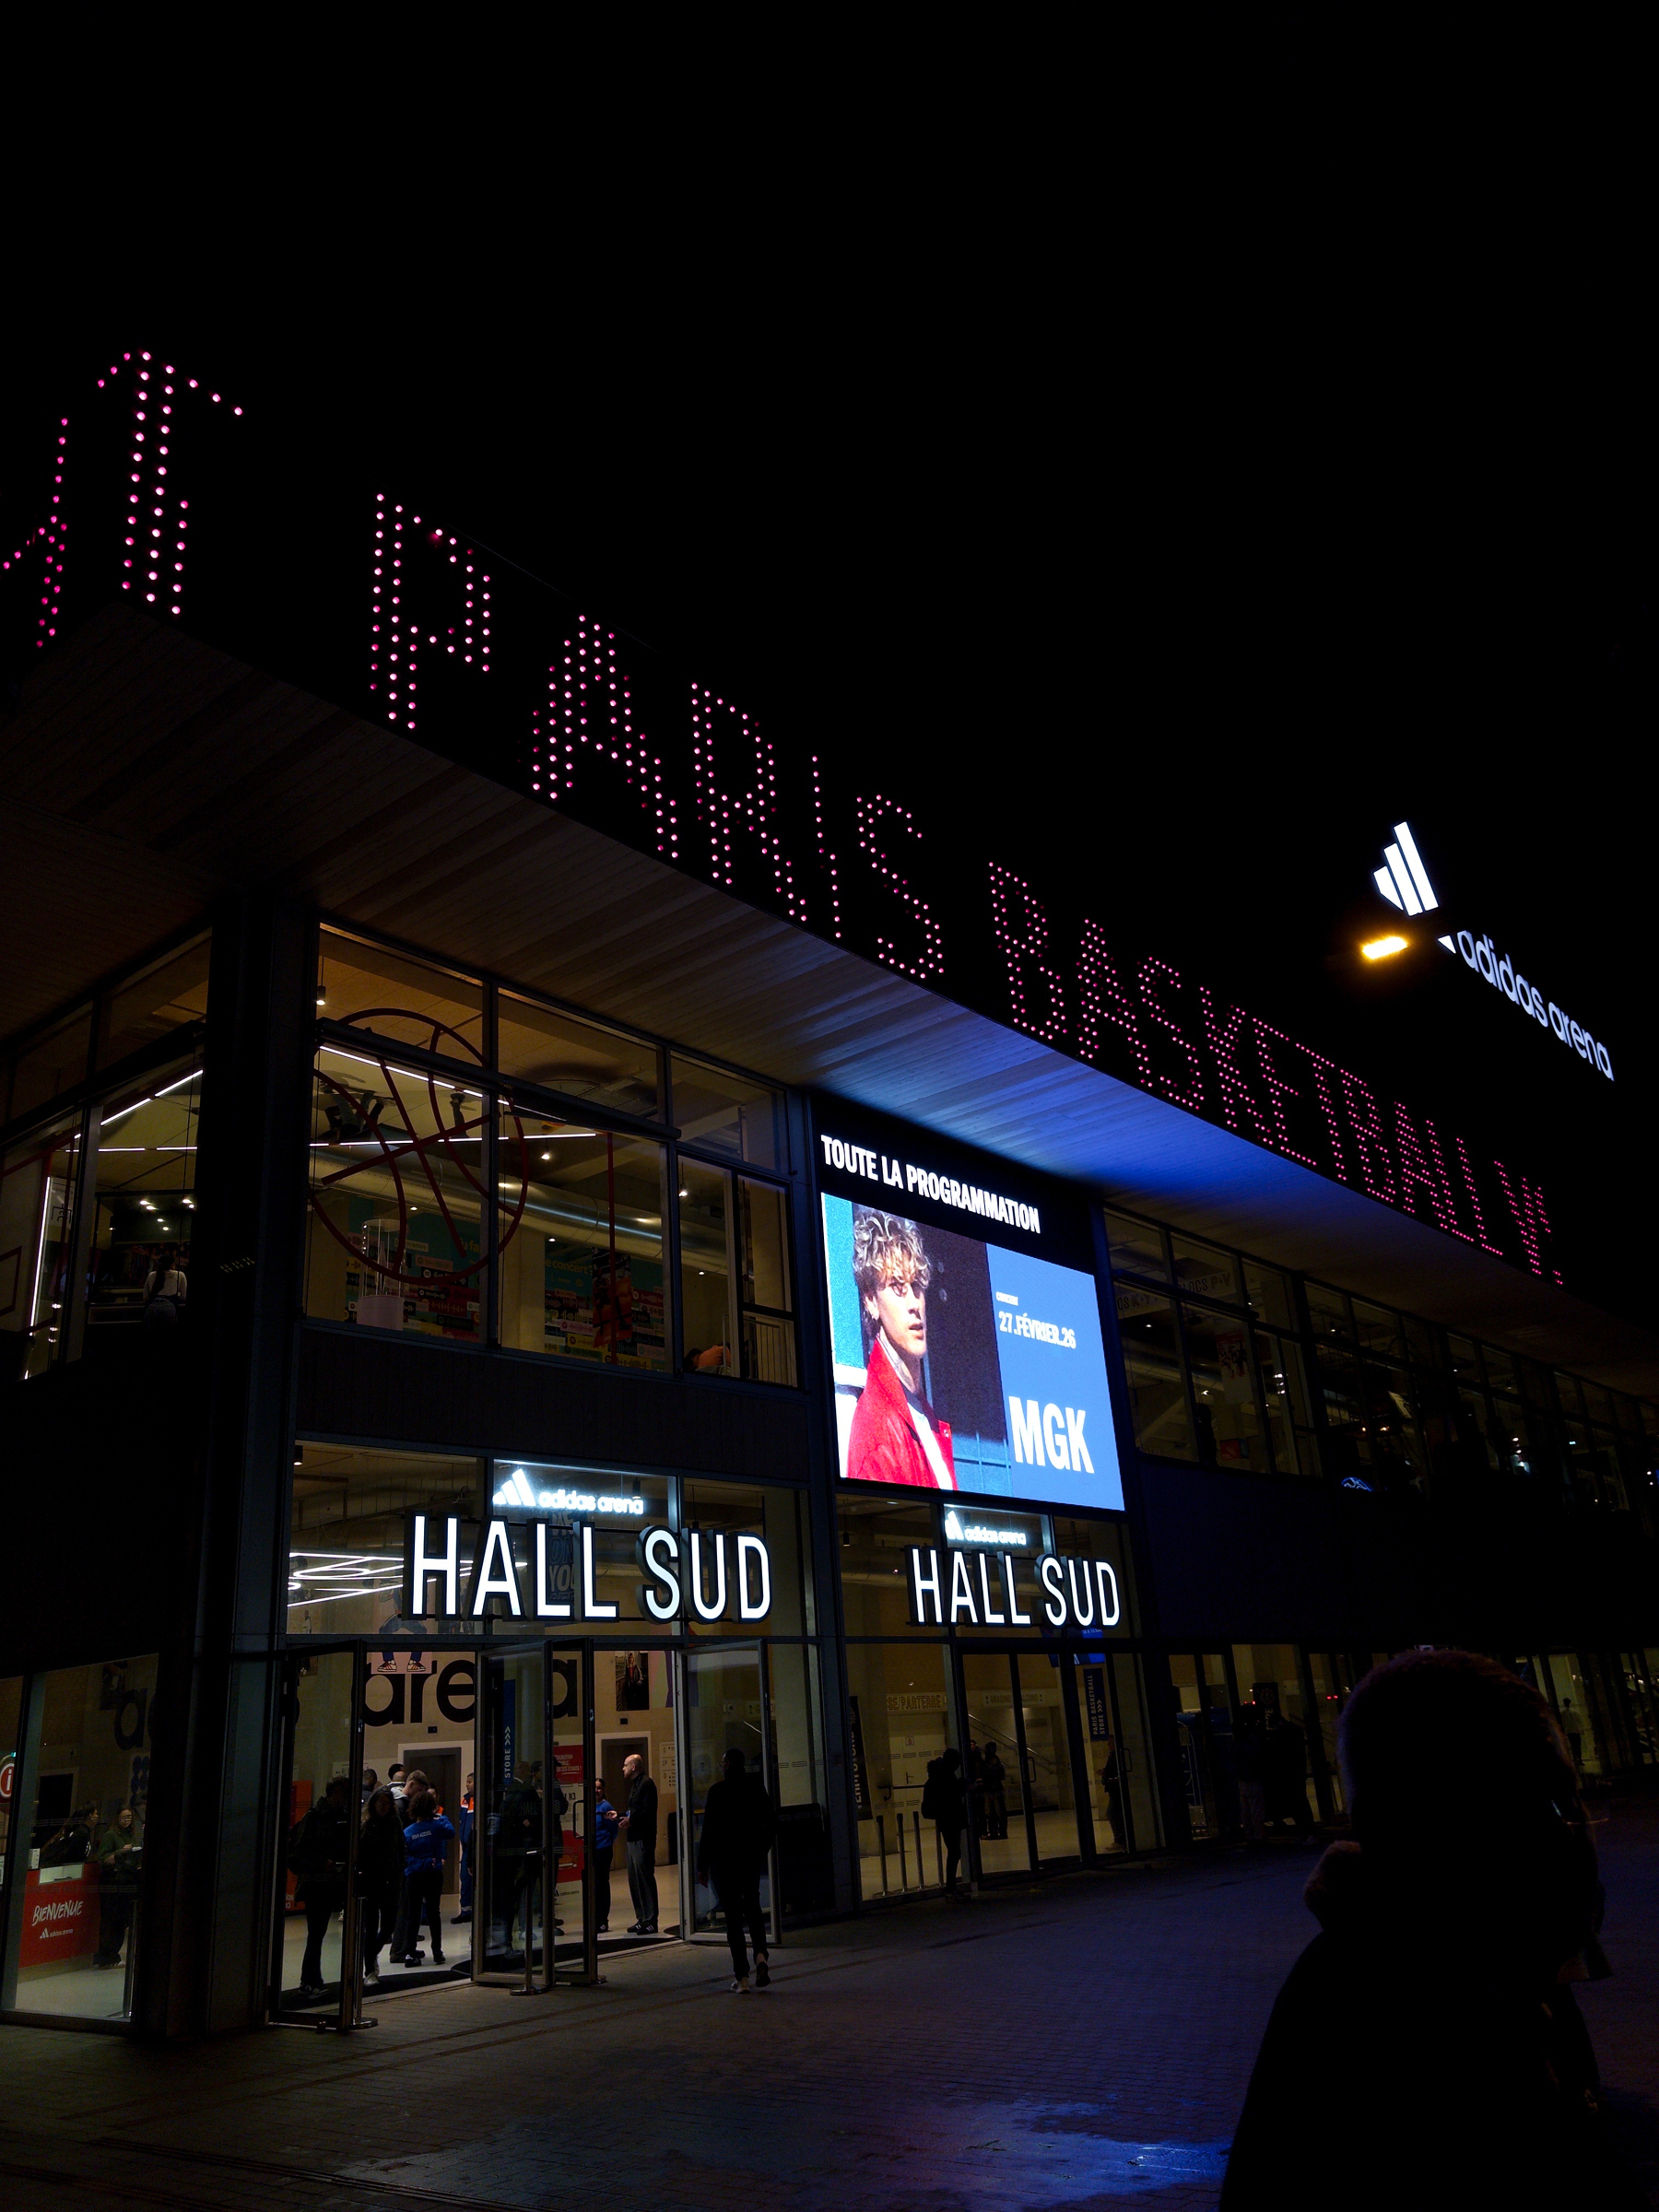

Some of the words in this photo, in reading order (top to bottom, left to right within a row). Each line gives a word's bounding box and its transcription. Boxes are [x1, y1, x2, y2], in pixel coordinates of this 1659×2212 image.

[371, 492, 945, 980] PARIS
[987, 860, 1507, 1257] BASKETBALL
[1456, 930, 1549, 1028] adidas
[1547, 1001, 1615, 1082] arena
[820, 1134, 878, 1182] TOUTE
[881, 1156, 904, 1190] LA
[905, 1162, 1041, 1234] PROGRAMMATION
[1008, 1395, 1095, 1475] MGK
[537, 1488, 596, 1512] adidas
[597, 1495, 644, 1514] arena
[412, 1515, 620, 1618] HALL
[644, 1530, 771, 1619] SUD
[912, 1547, 1031, 1625] HALL
[1041, 1554, 1121, 1627] SUD
[31, 1900, 84, 1927] BIENVENUE
